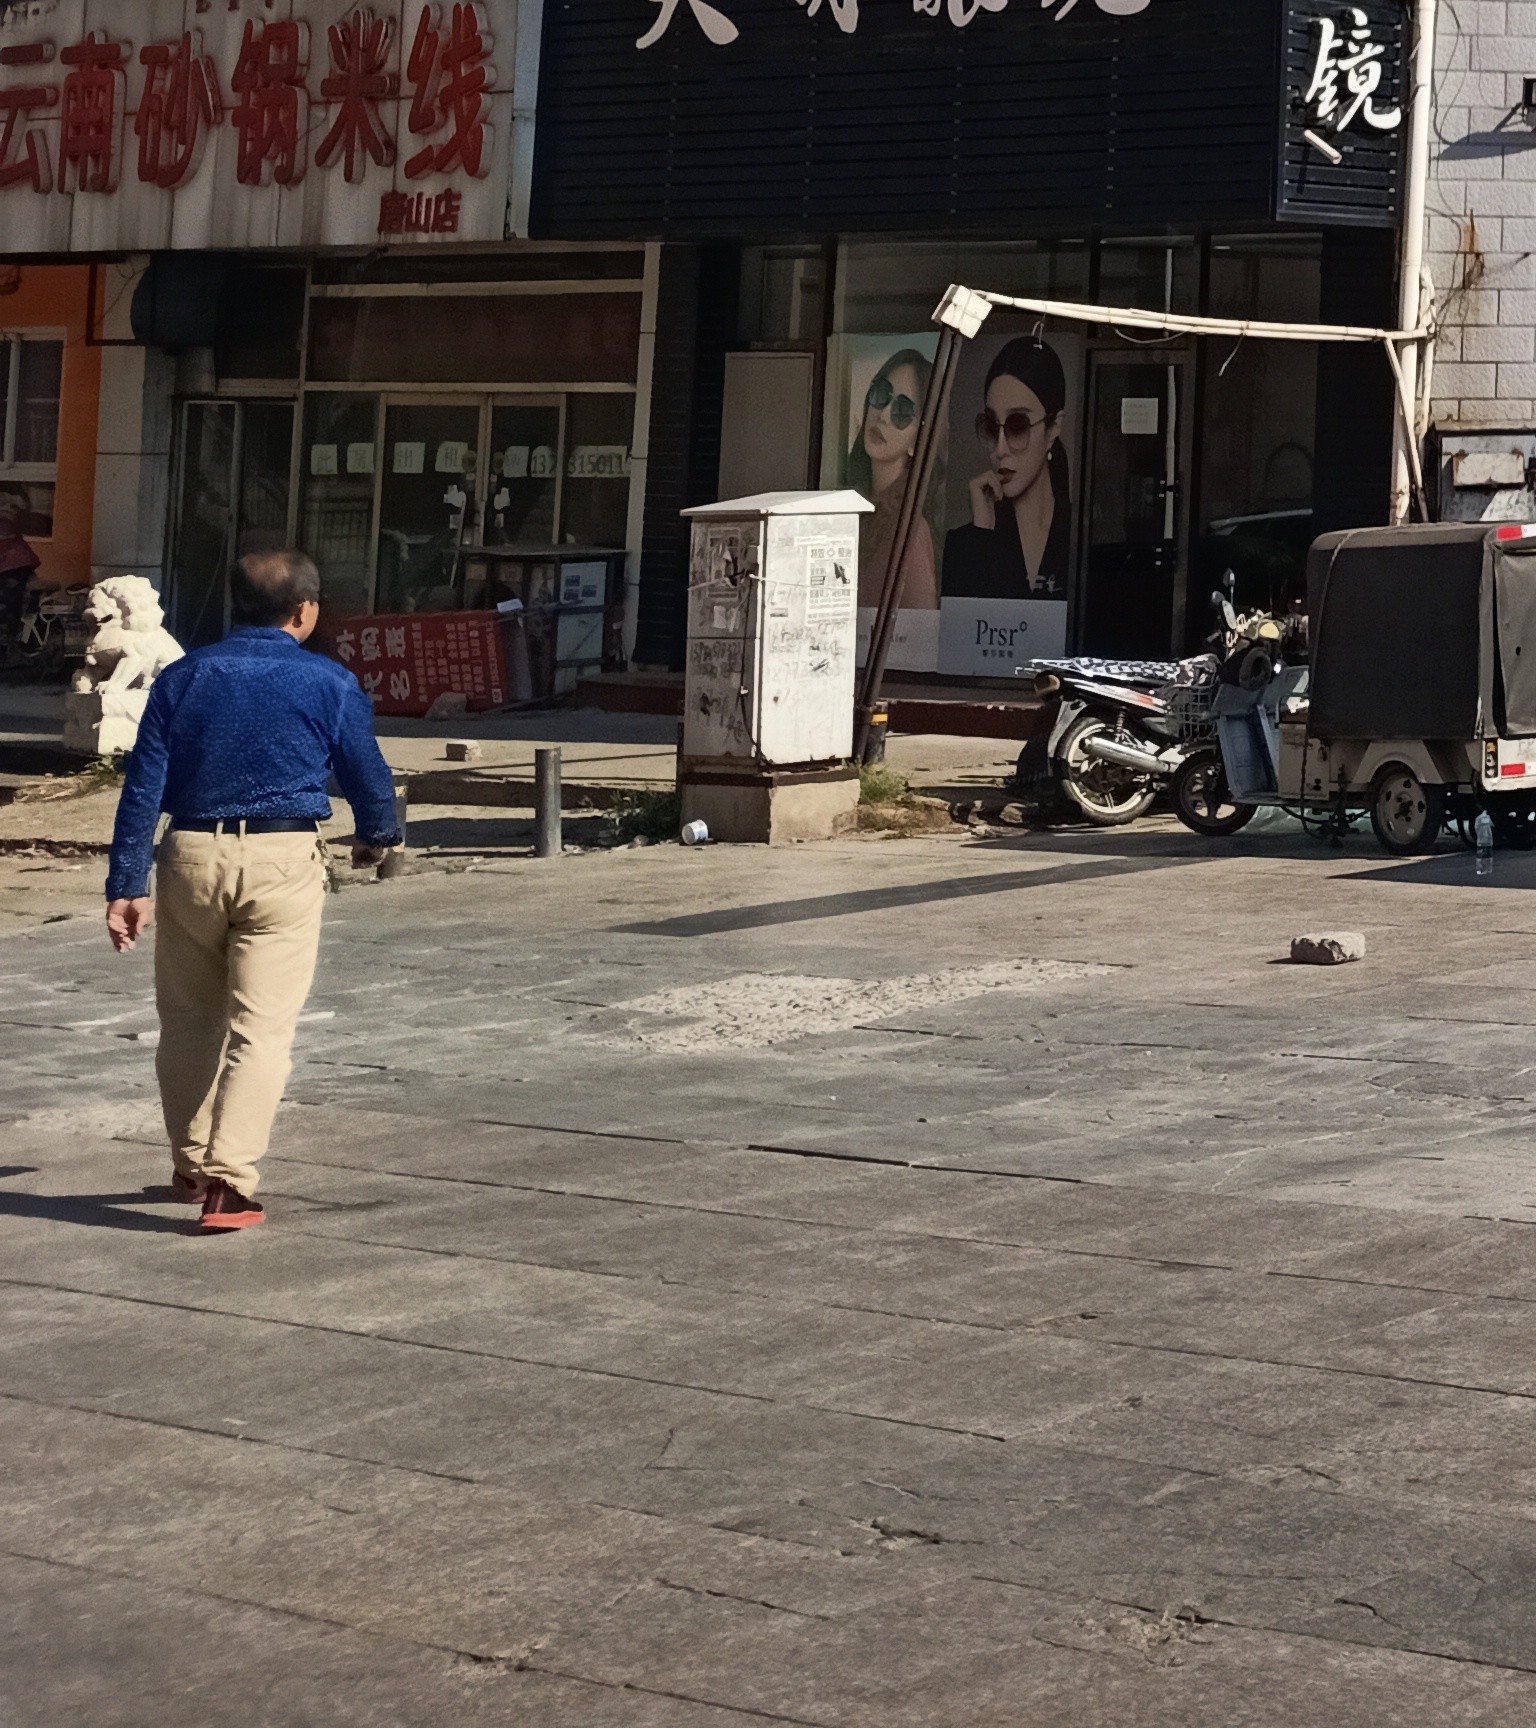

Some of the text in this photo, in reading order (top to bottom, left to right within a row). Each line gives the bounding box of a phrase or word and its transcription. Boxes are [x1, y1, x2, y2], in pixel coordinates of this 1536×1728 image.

[0, 1, 495, 194] 云南砂锅米线
